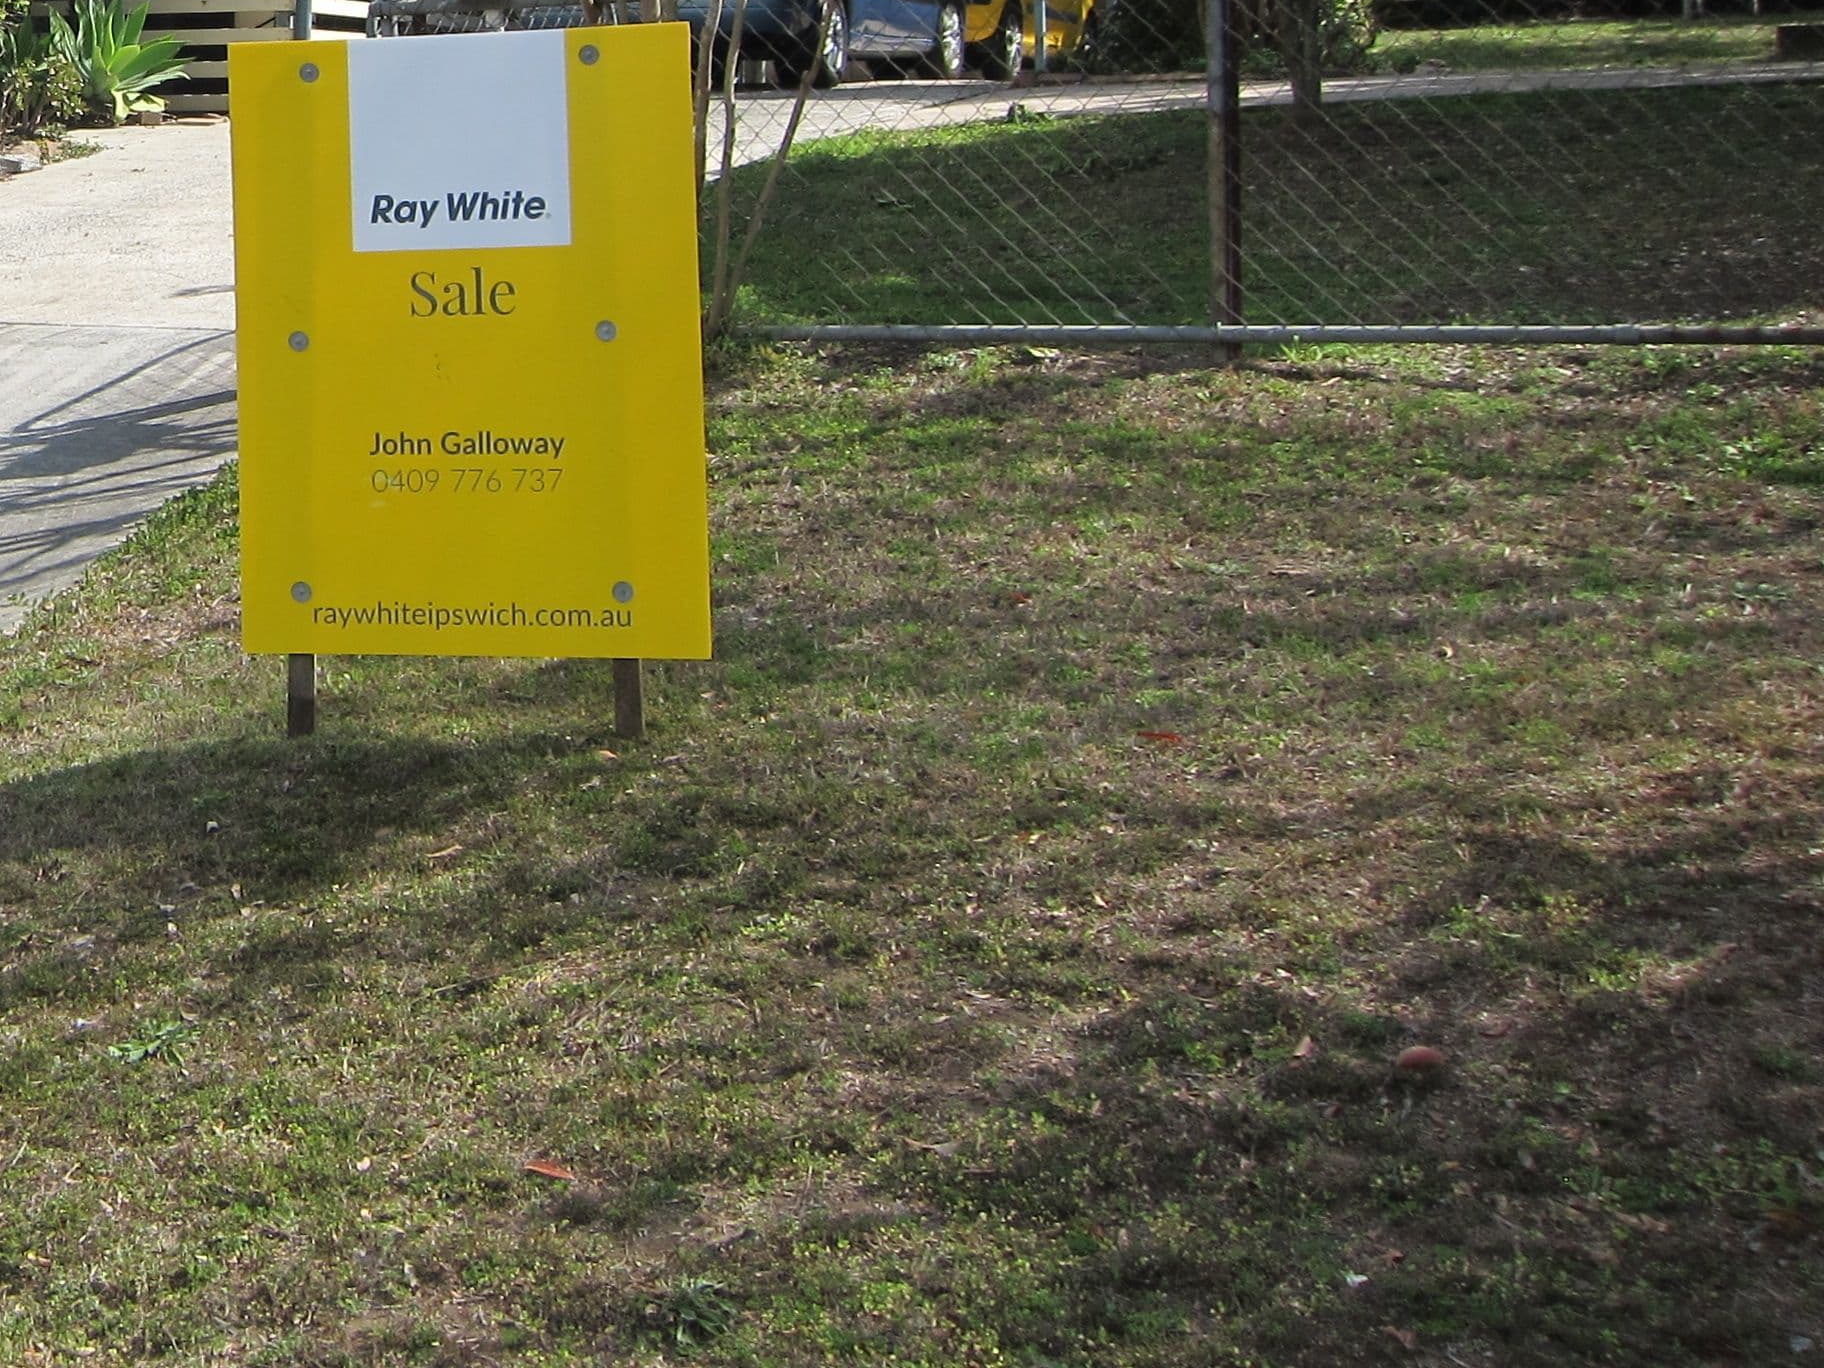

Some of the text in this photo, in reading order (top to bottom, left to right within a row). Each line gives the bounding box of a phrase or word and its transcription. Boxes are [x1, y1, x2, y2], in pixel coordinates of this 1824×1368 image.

[370, 190, 547, 229] Ray White
[409, 266, 517, 318] Sale
[369, 430, 566, 460] John Galloway
[371, 468, 564, 494] 0409 776 737
[312, 600, 633, 631] raywhiteipswich.com.au
